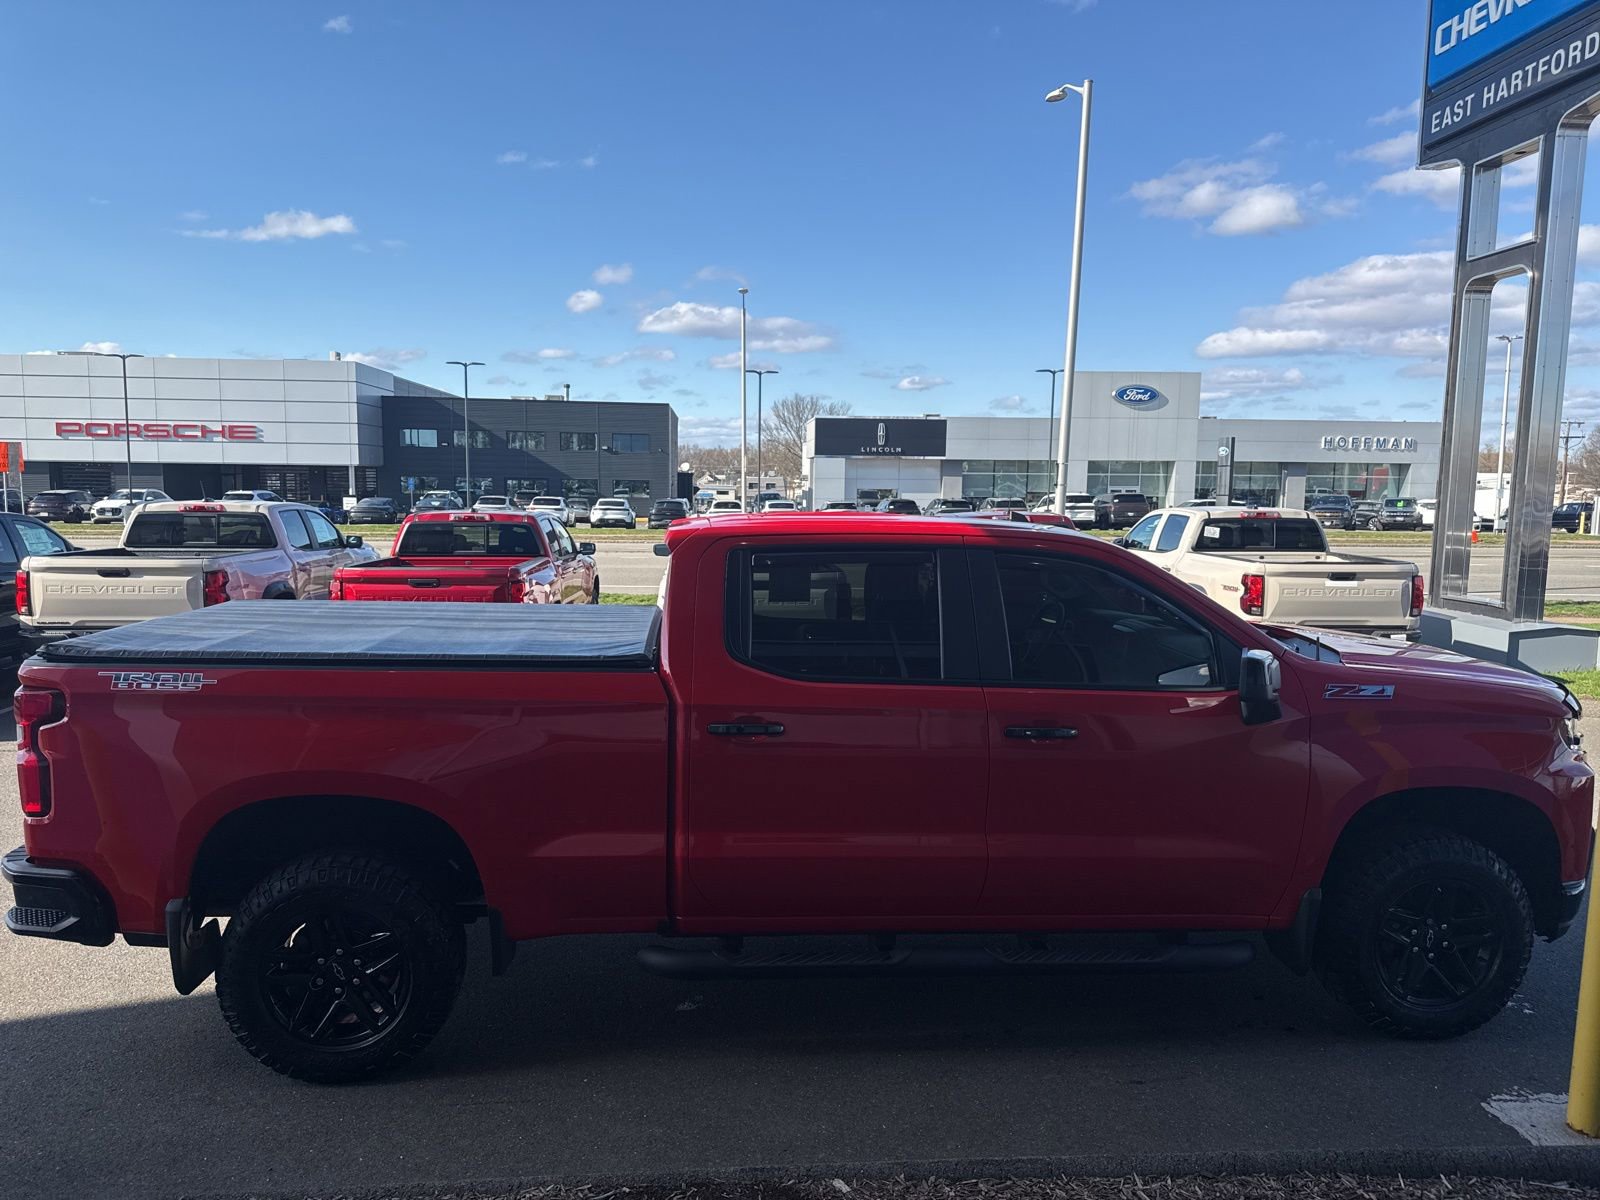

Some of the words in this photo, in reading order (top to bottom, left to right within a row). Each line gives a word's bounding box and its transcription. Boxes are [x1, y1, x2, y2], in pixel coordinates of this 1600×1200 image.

[1431, 93, 1476, 134] EAST
[1482, 31, 1600, 109] HARTFORD
[1123, 388, 1151, 401] Ford
[55, 421, 258, 440] PORSCHE
[1321, 436, 1414, 450] HOFFMAN
[45, 584, 184, 595] CHEVROLET
[1281, 587, 1400, 598] CHEVROLET
[1323, 683, 1395, 699] Z71
